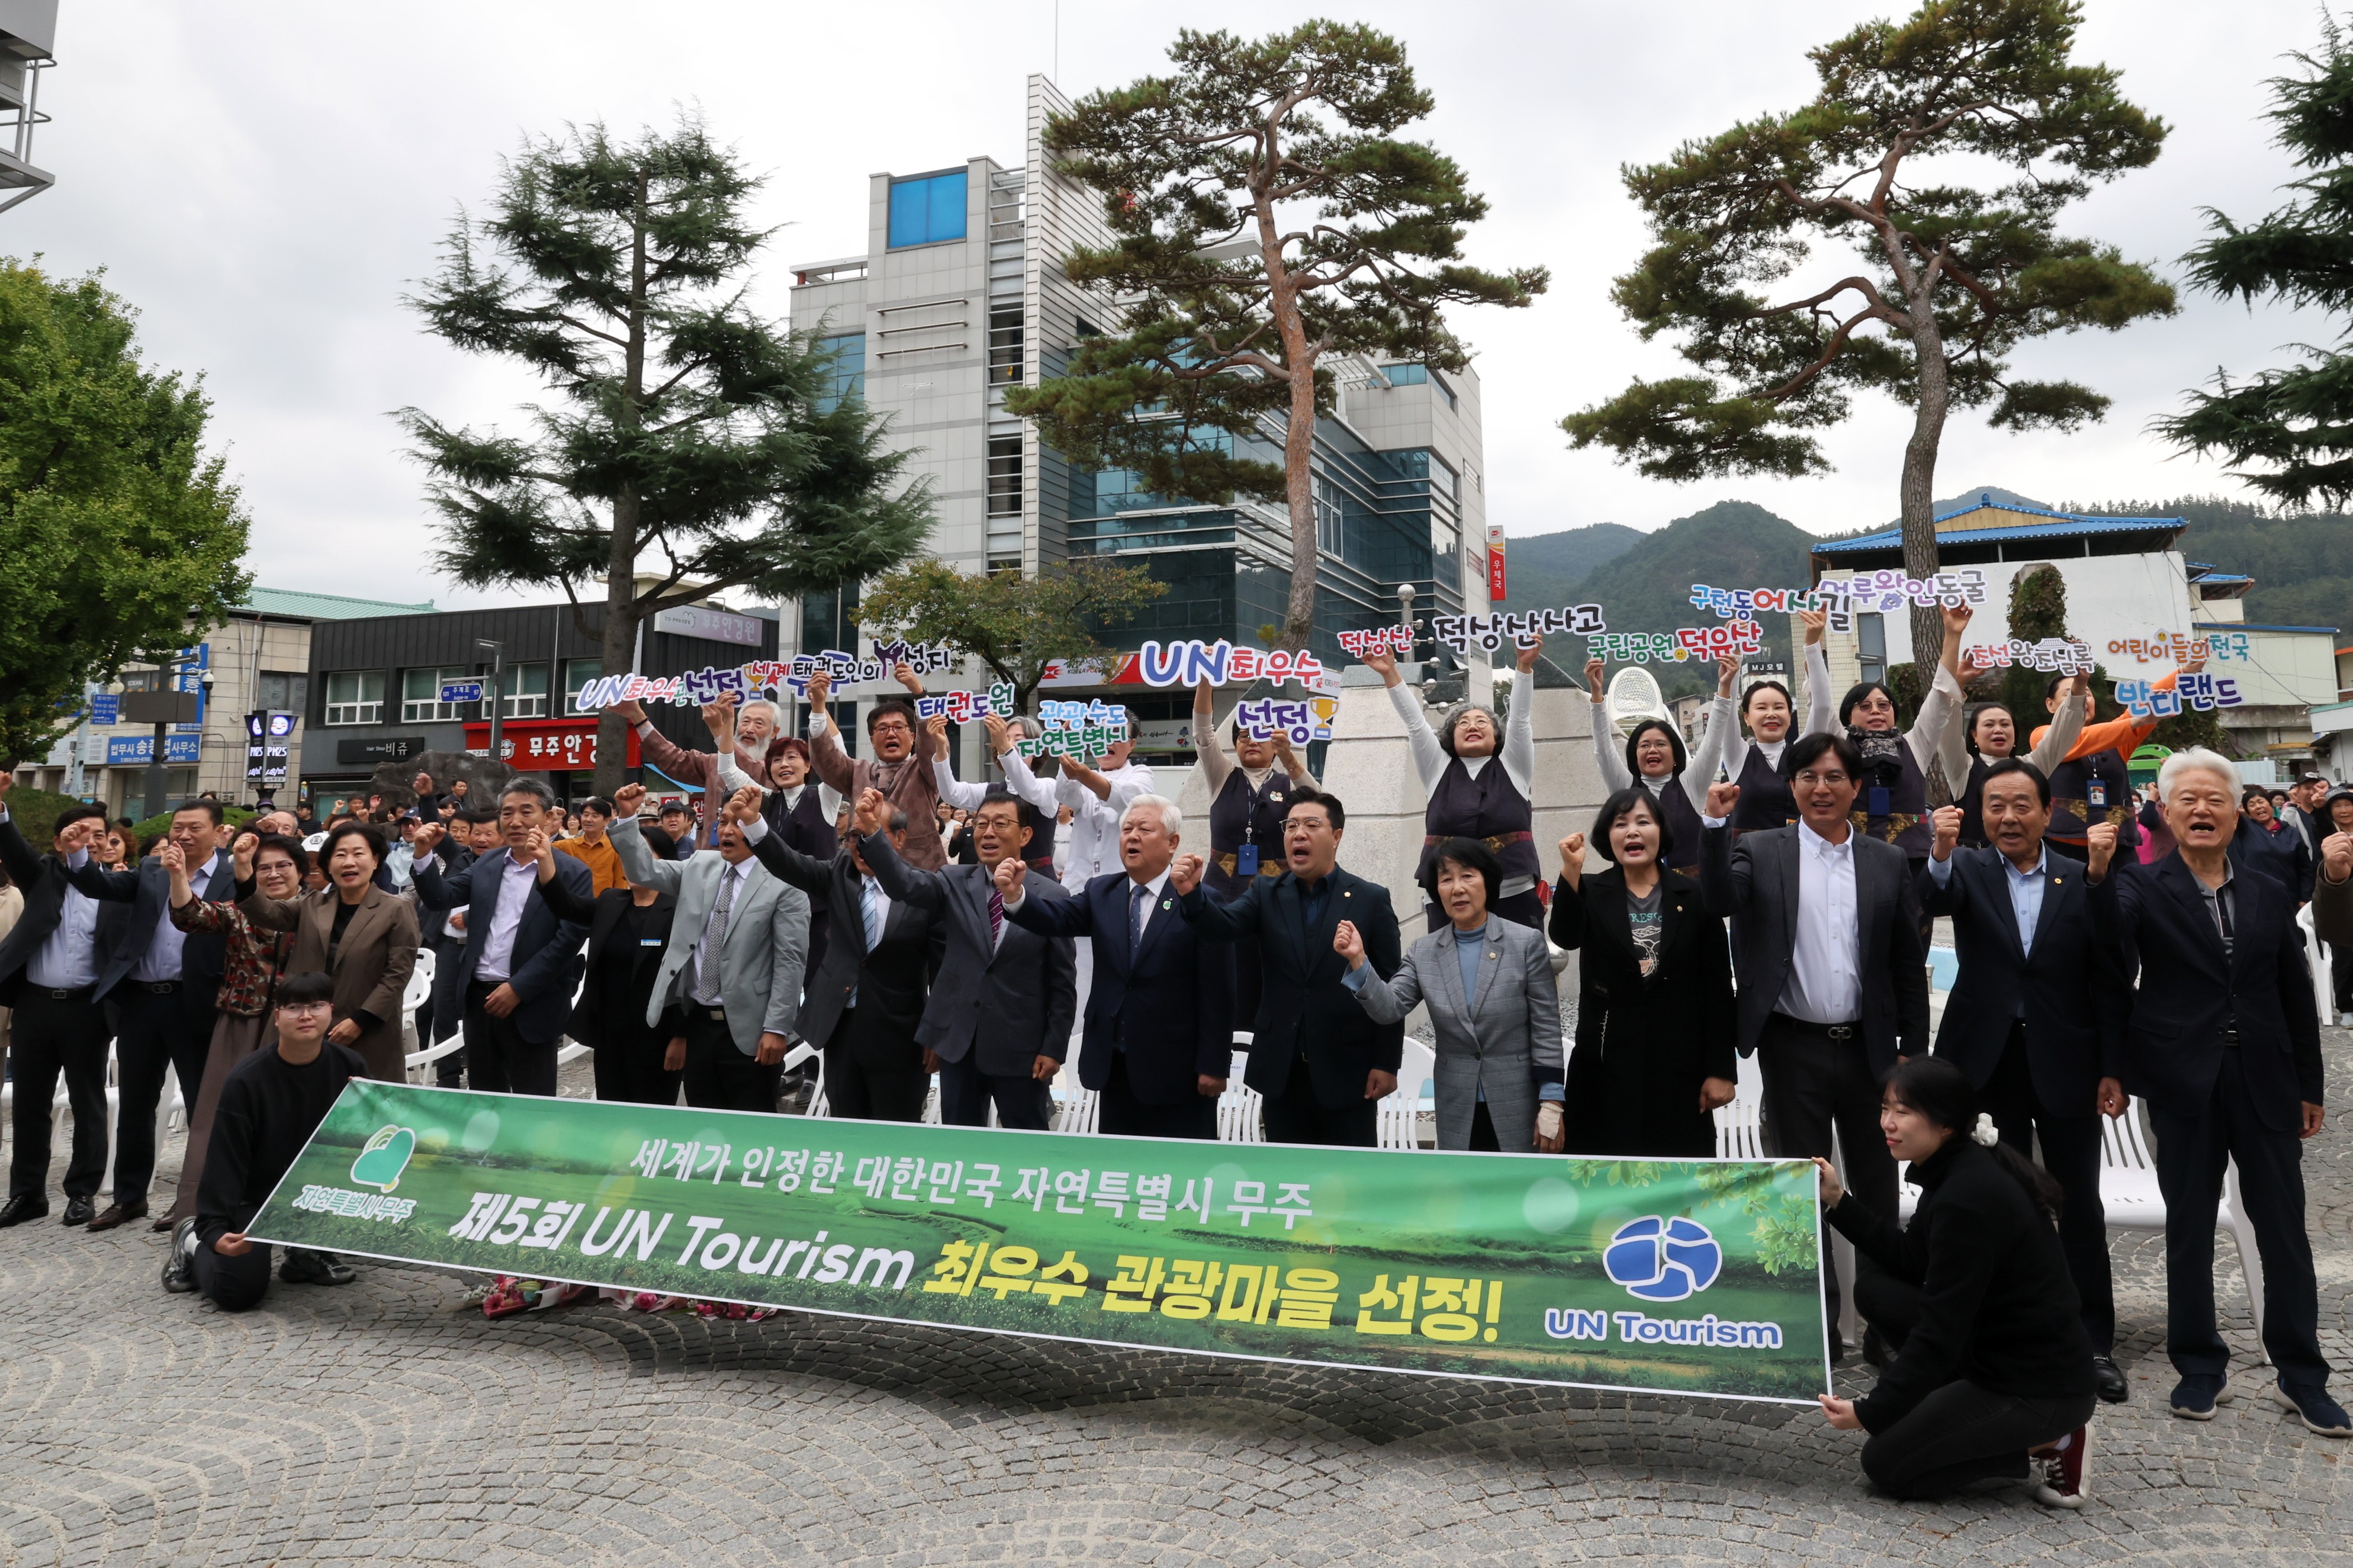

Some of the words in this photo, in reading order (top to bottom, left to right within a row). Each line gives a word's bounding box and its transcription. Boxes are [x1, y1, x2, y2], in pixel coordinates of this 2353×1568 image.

[1493, 559, 1502, 590] 우체국
[702, 613, 755, 643] 무주안경원
[1339, 626, 1414, 657] 적상산
[1435, 605, 1602, 652] 적상산사고
[1589, 633, 1673, 663] 국립공원
[1678, 622, 1761, 660] 덕유산
[753, 661, 791, 677] 세계
[905, 645, 951, 674] 성지
[1972, 639, 2094, 676] 조선왕조실록
[2108, 633, 2210, 664] 어린이들의
[2210, 634, 2249, 662] 천국
[1230, 649, 1320, 685] 최우수
[452, 685, 470, 694] 주계로
[686, 668, 745, 706] 선정
[918, 682, 1013, 723] 태권도원
[2118, 674, 2242, 715] 반디랜드
[1040, 700, 1126, 729] 관광수도
[1239, 700, 1310, 743] 선정
[111, 744, 135, 756] 법무사
[171, 741, 197, 754] 사무소
[385, 742, 409, 756] 비쥬
[1017, 725, 1127, 762] 자연특별시
[630, 1138, 732, 1185] 세계가
[741, 1146, 845, 1194] 인정한
[853, 1156, 1003, 1209] 대한민국
[1011, 1167, 1212, 1225] 자연특별시
[1226, 1180, 1313, 1231] 무주
[448, 1192, 586, 1251] 제5회
[580, 1205, 674, 1263] UN
[677, 1215, 915, 1291] Tourism
[922, 1239, 1089, 1306] 최우수
[1101, 1254, 1340, 1330] 관광마을
[1355, 1273, 1504, 1343] 선정!
[1548, 1311, 1603, 1338] UN
[1620, 1314, 1780, 1347] Tourism
